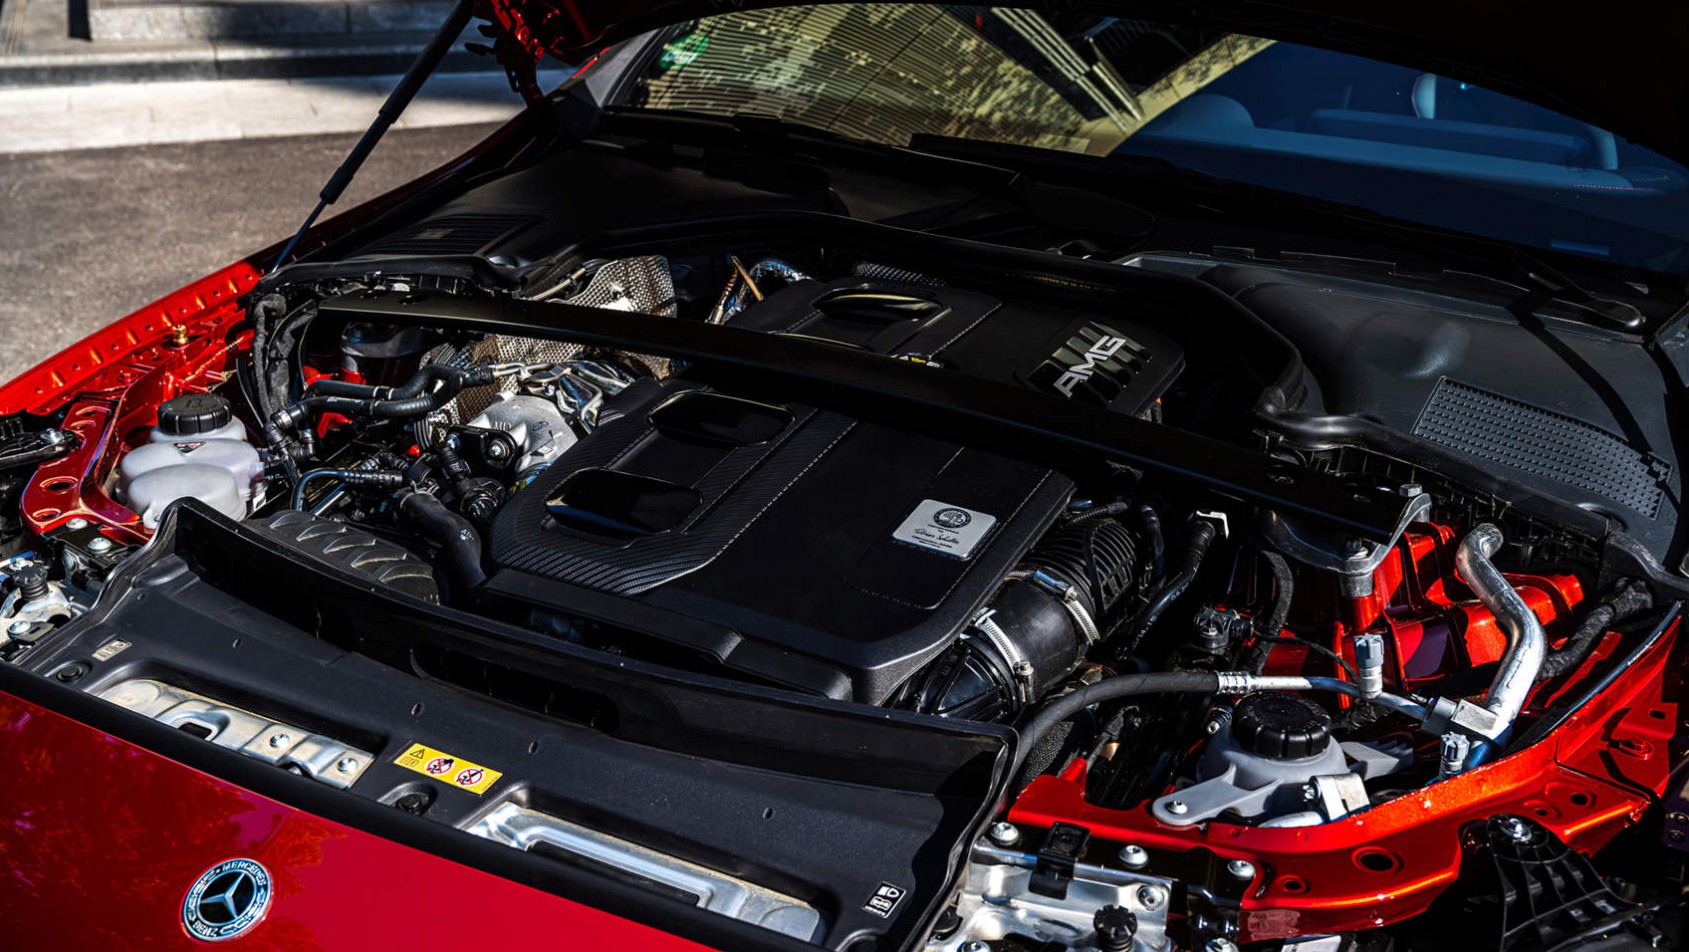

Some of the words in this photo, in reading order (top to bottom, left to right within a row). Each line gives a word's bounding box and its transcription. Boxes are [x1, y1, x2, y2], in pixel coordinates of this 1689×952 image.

[1053, 335, 1126, 398] AMG
[222, 861, 267, 886] MERCEDES
[192, 920, 219, 938] BENZ
